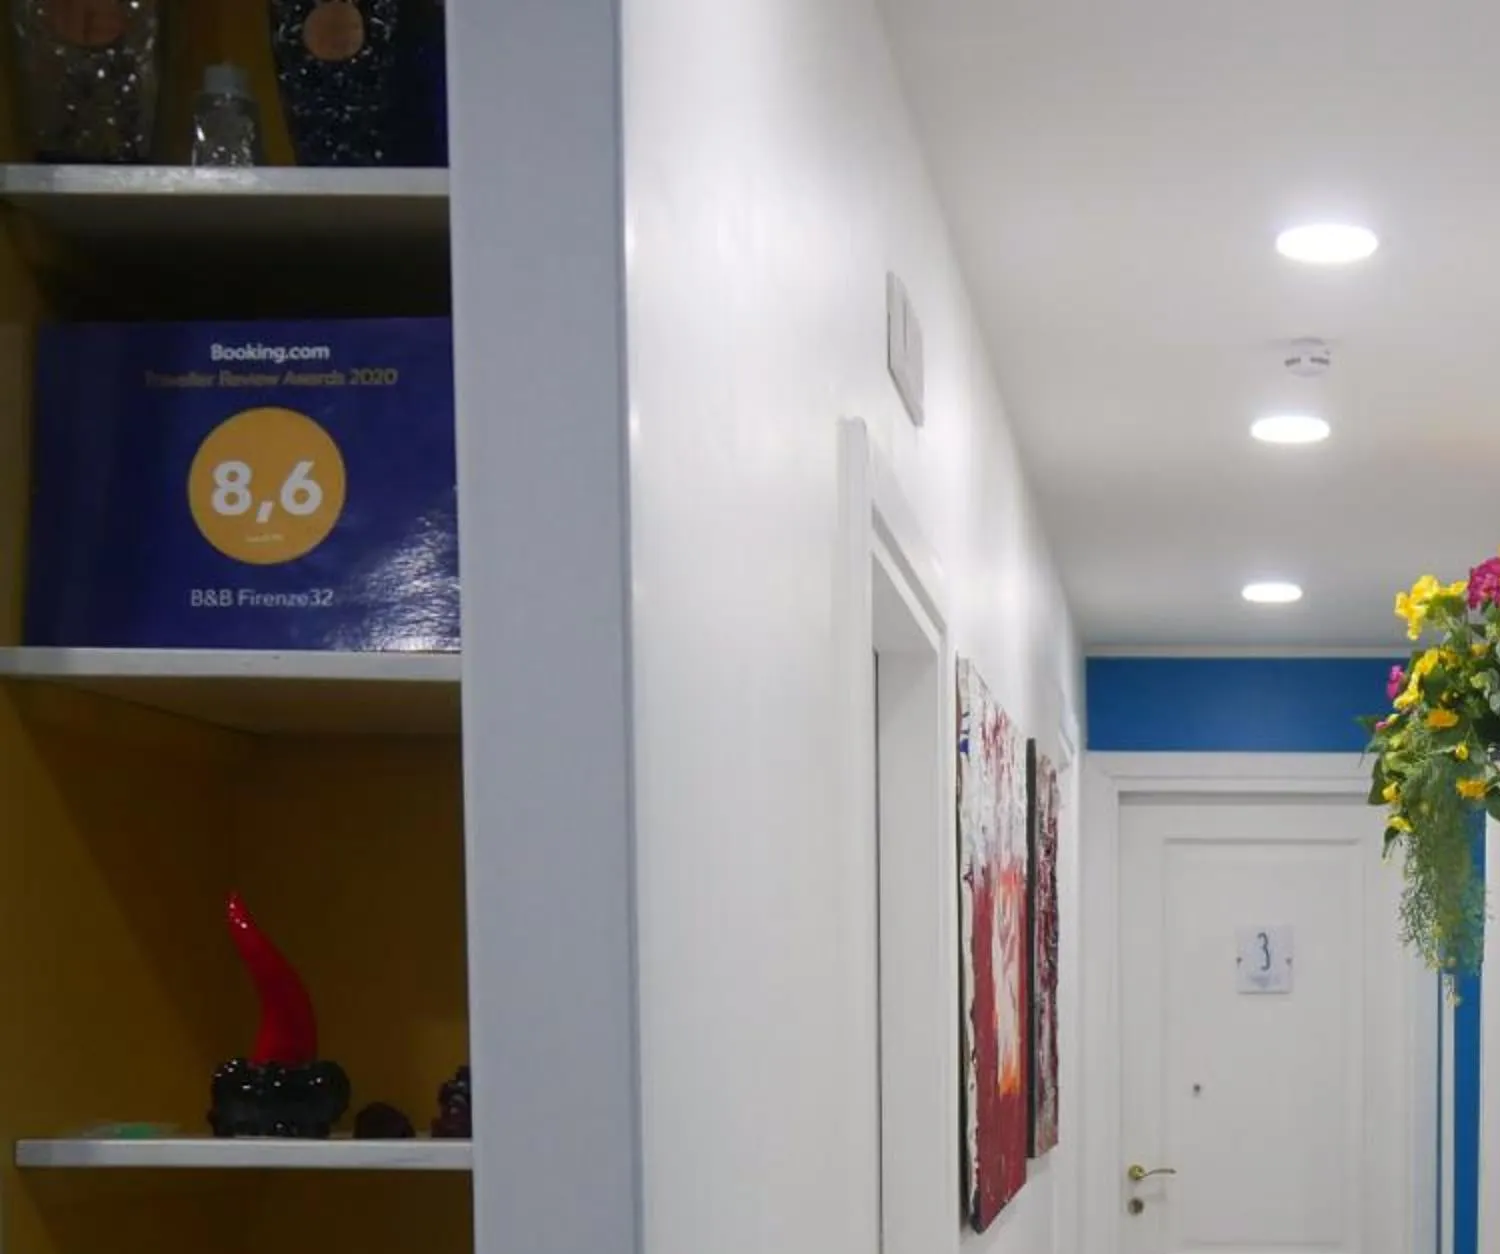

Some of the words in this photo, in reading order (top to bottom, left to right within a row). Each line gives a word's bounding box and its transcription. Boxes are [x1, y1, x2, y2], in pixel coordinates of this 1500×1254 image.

[210, 343, 331, 363] Booking.com
[347, 368, 398, 386] 2020
[211, 460, 323, 523] 8,6
[191, 588, 233, 607] B&B
[238, 588, 334, 607] Firenze32
